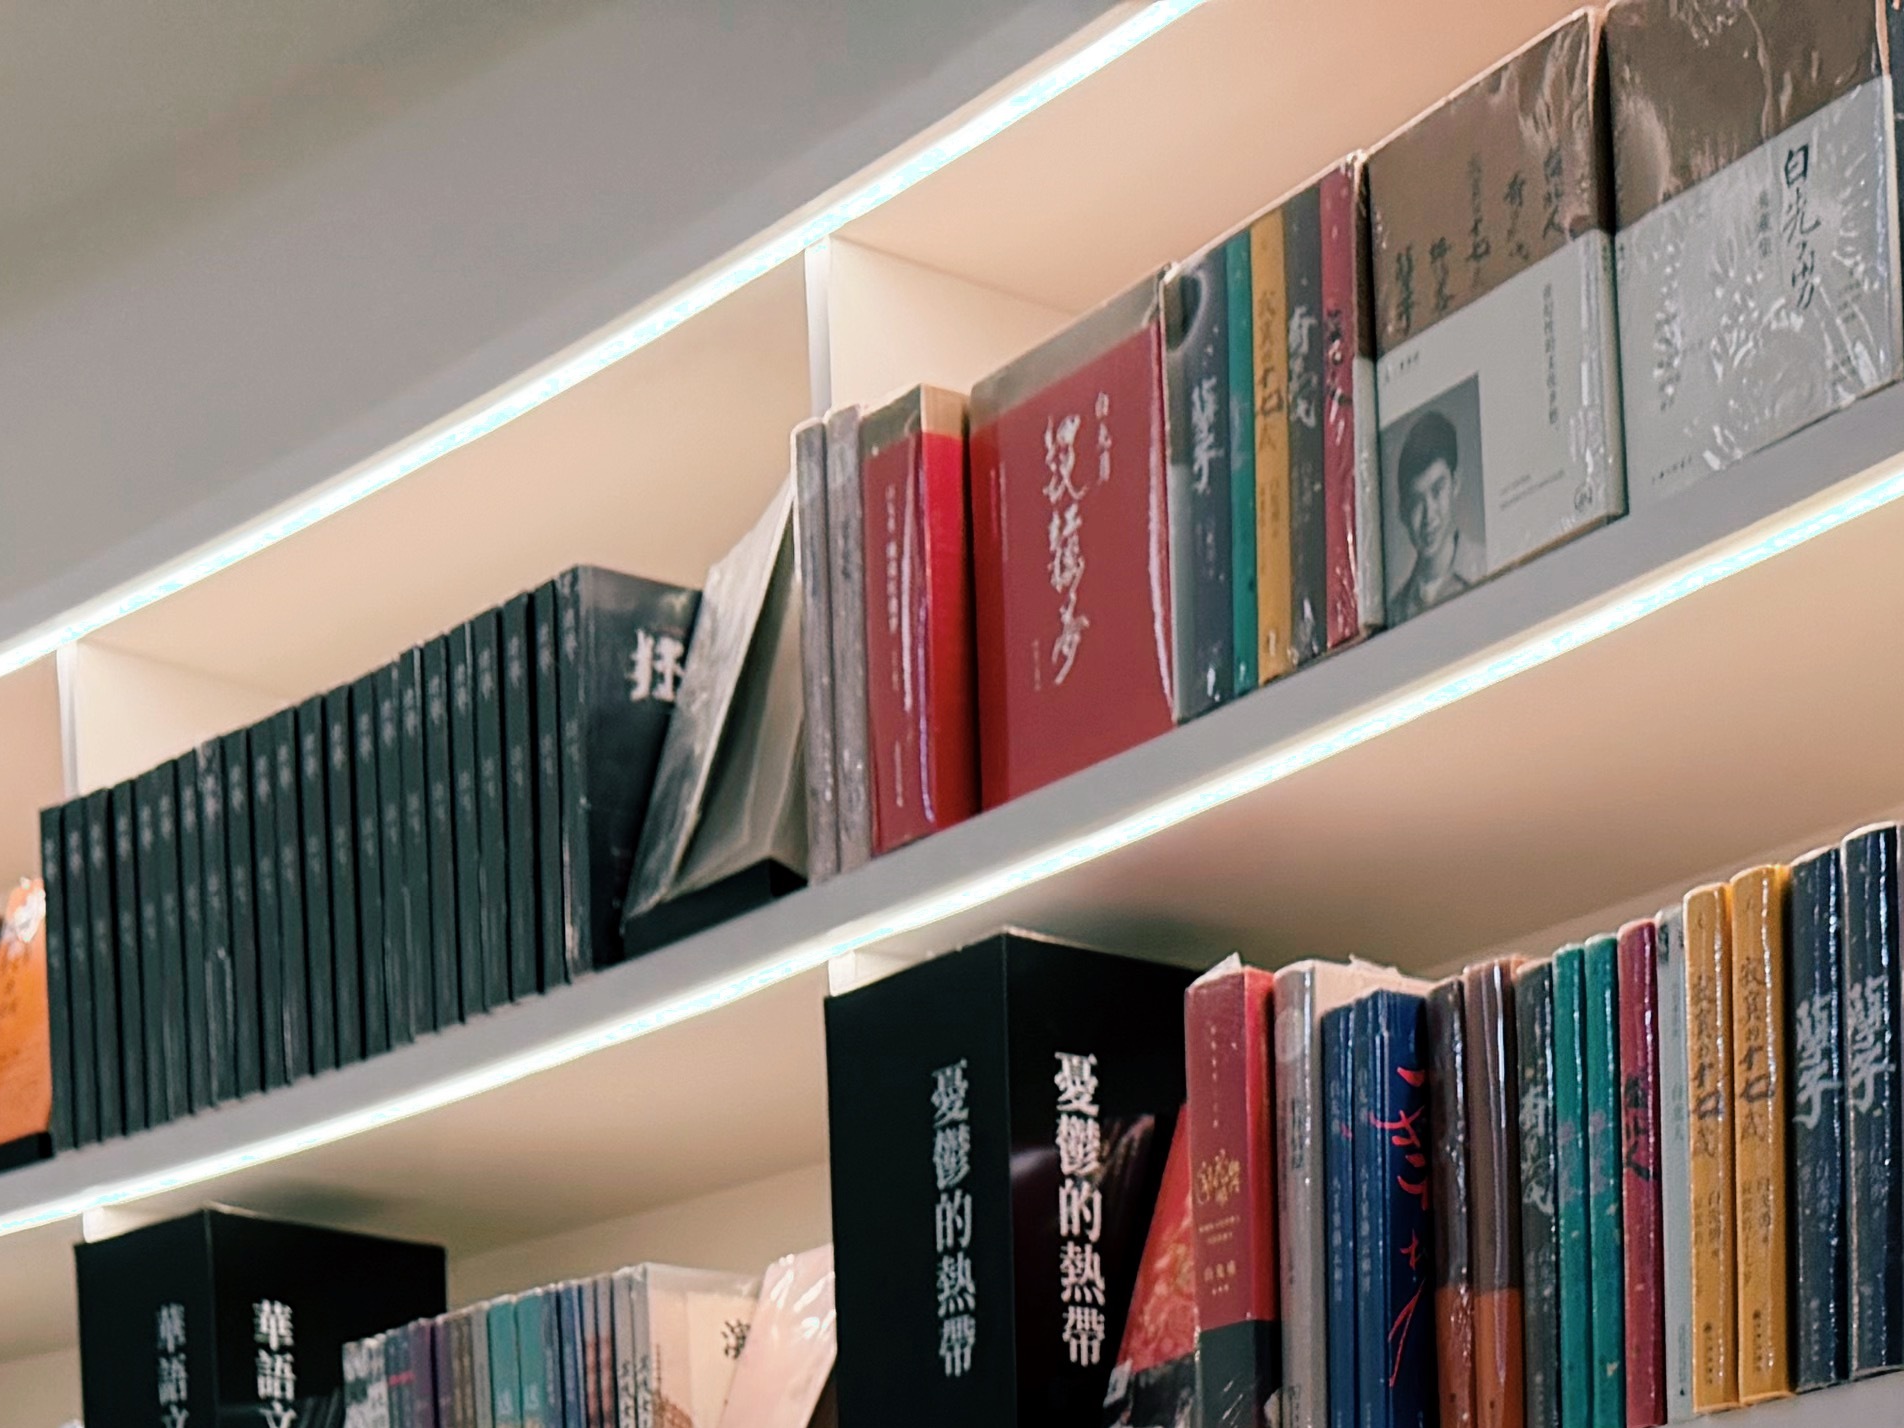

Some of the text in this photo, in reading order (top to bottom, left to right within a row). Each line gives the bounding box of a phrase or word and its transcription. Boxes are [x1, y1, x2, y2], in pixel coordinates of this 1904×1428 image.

[1783, 144, 1821, 309] 白先勇
[931, 1058, 976, 1377] 憂鬱的熱帶
[1054, 1051, 1106, 1367] 憂鬱的熱帶
